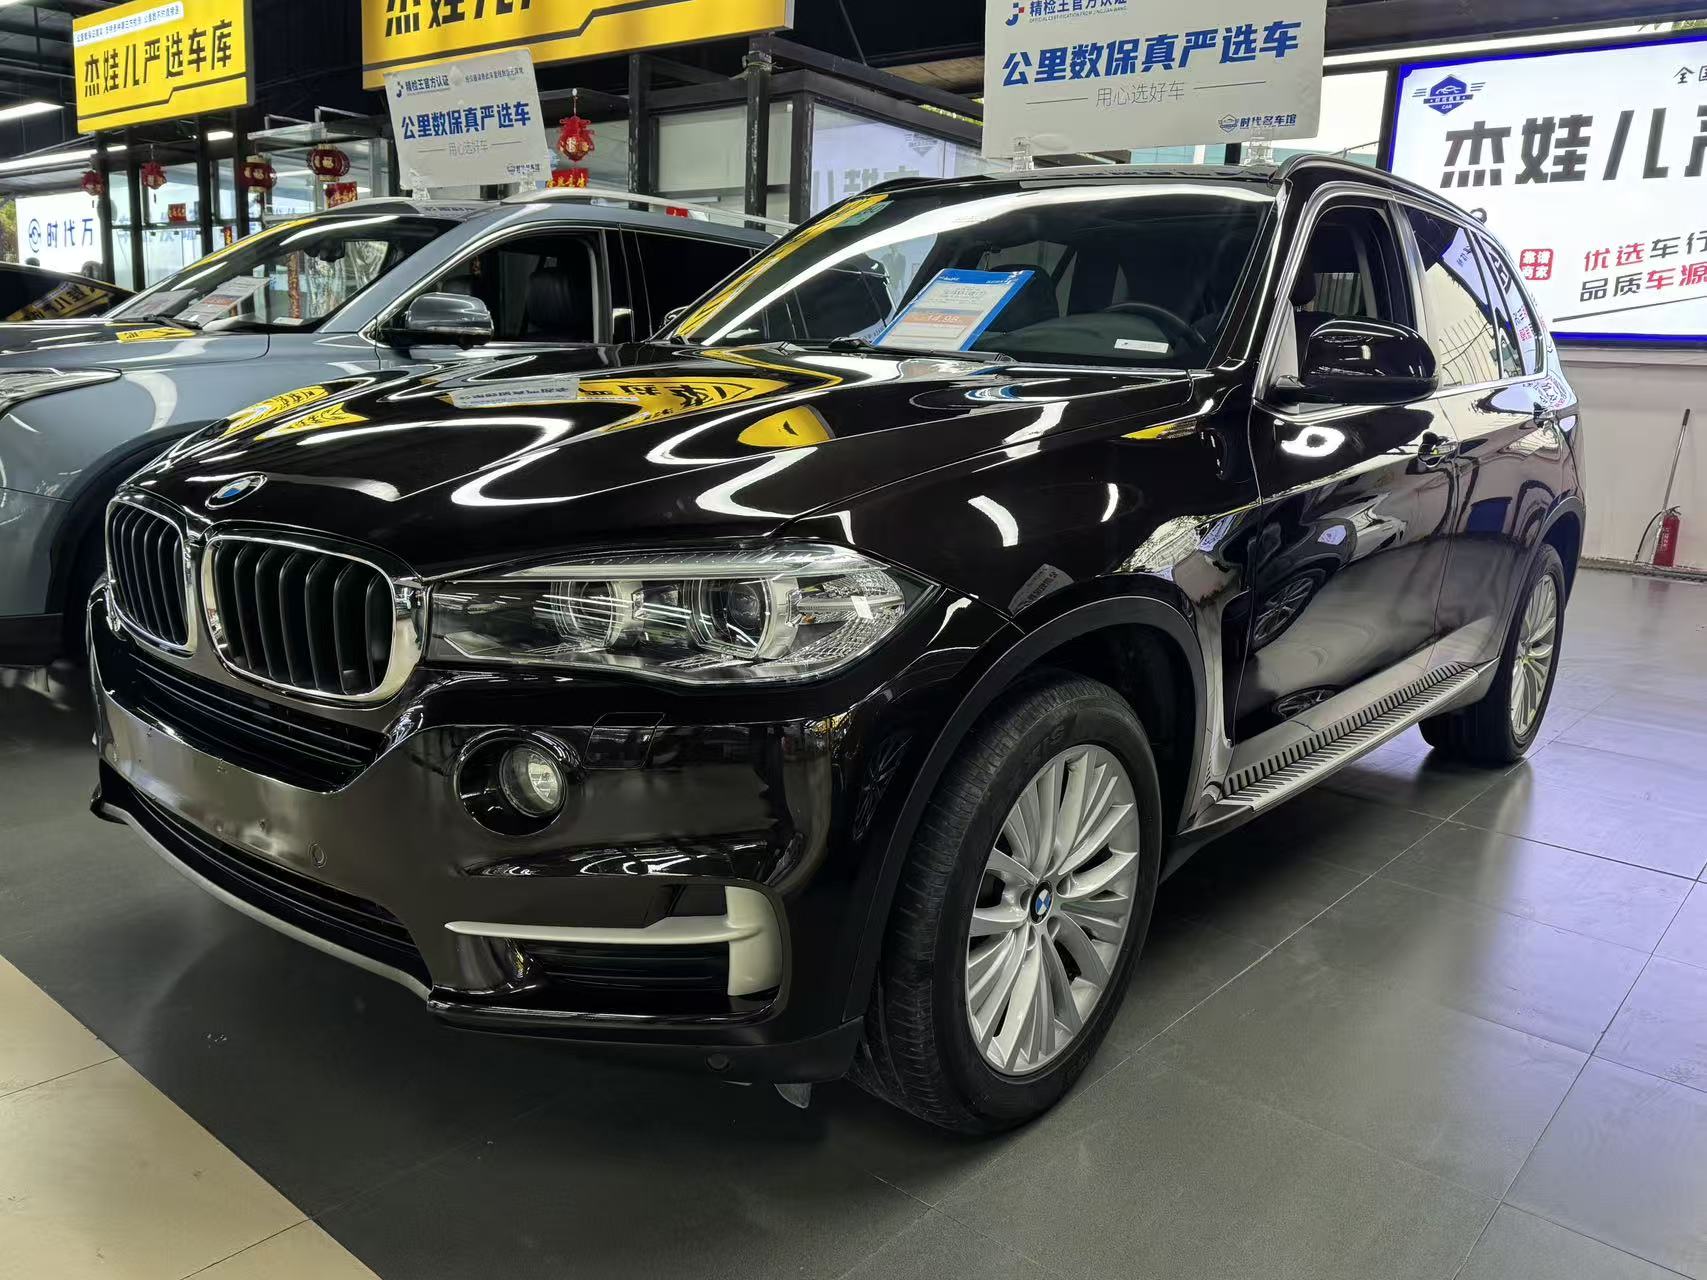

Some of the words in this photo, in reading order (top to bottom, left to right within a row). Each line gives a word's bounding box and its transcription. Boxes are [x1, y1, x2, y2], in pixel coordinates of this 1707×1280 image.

[84, 19, 232, 98] 杰娃儿严选车库
[1002, 20, 1301, 86] 公里数保真严选车
[1095, 80, 1185, 108] 用心选好车
[401, 101, 531, 140] 公里数保真严选车
[1240, 113, 1297, 128] 时代名车馆
[1584, 230, 1707, 272] 优选车行
[1580, 261, 1707, 302] 品质车源
